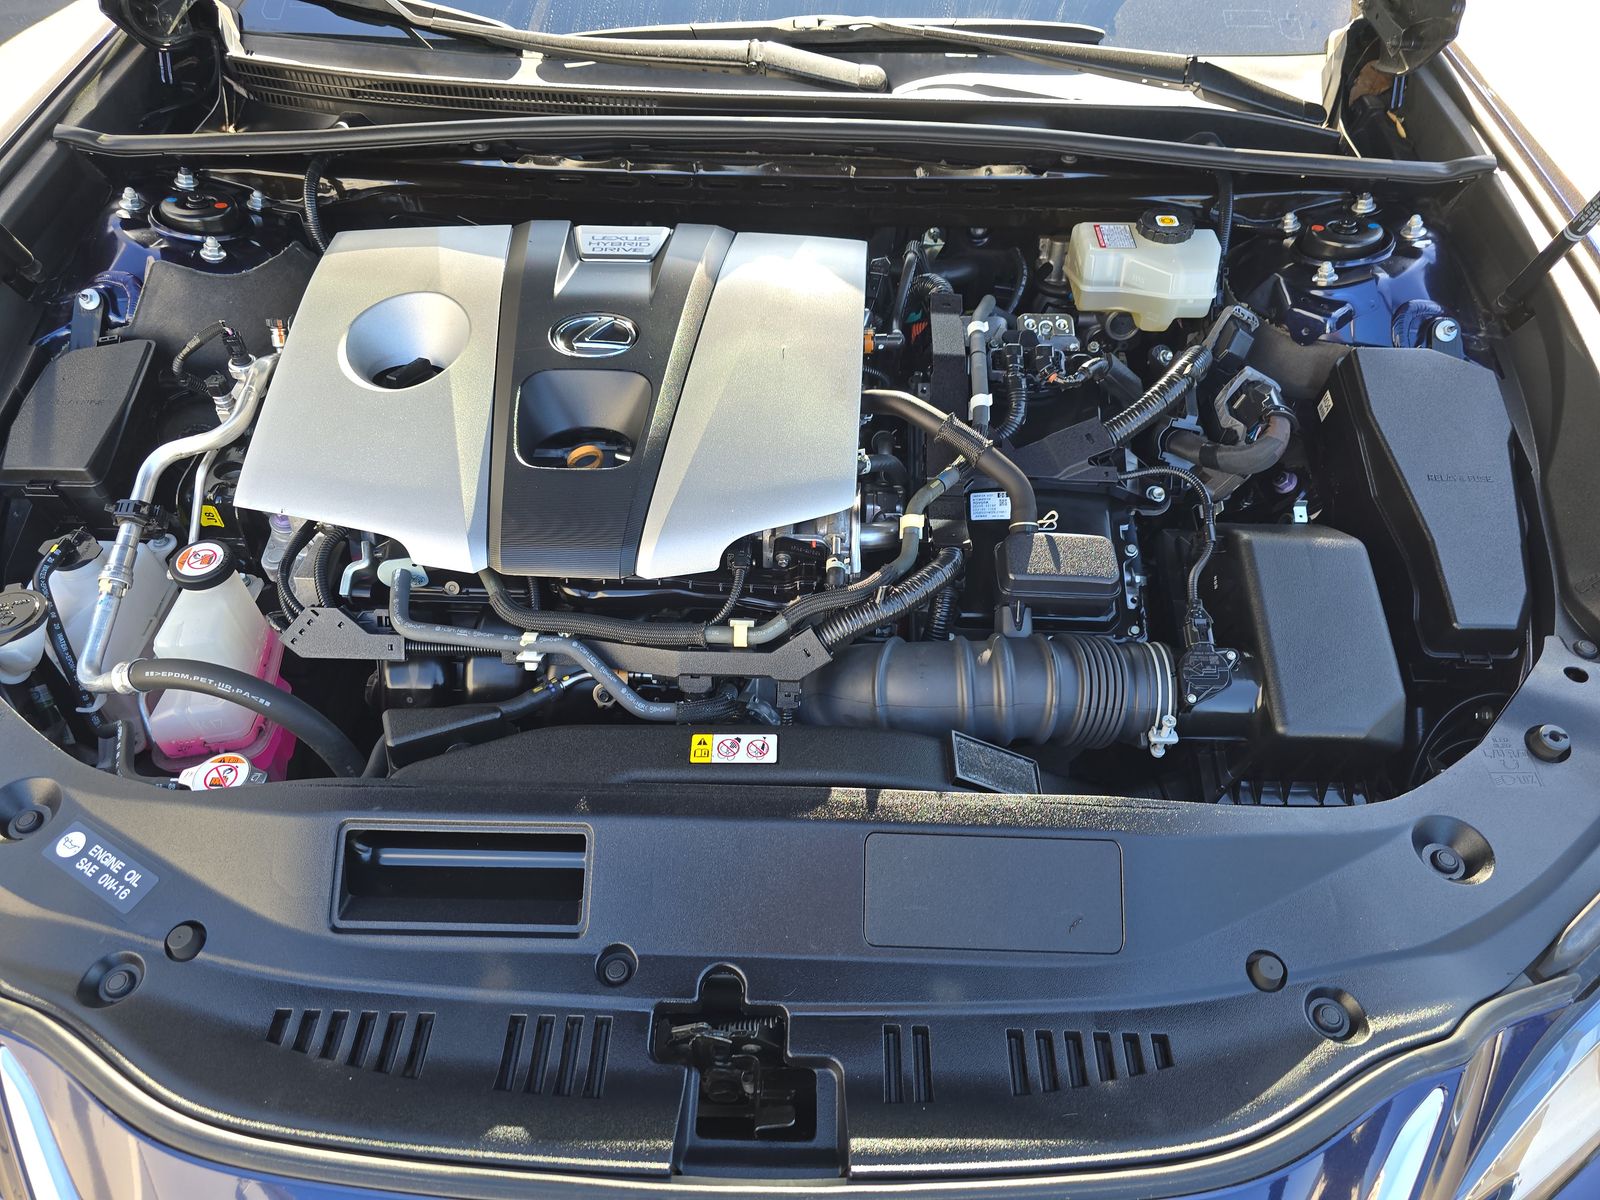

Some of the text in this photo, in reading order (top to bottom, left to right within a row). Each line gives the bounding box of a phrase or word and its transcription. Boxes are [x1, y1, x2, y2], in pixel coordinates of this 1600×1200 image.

[75, 857, 131, 900] SAE 0W-16
[88, 844, 142, 888] ENGINE OIL
